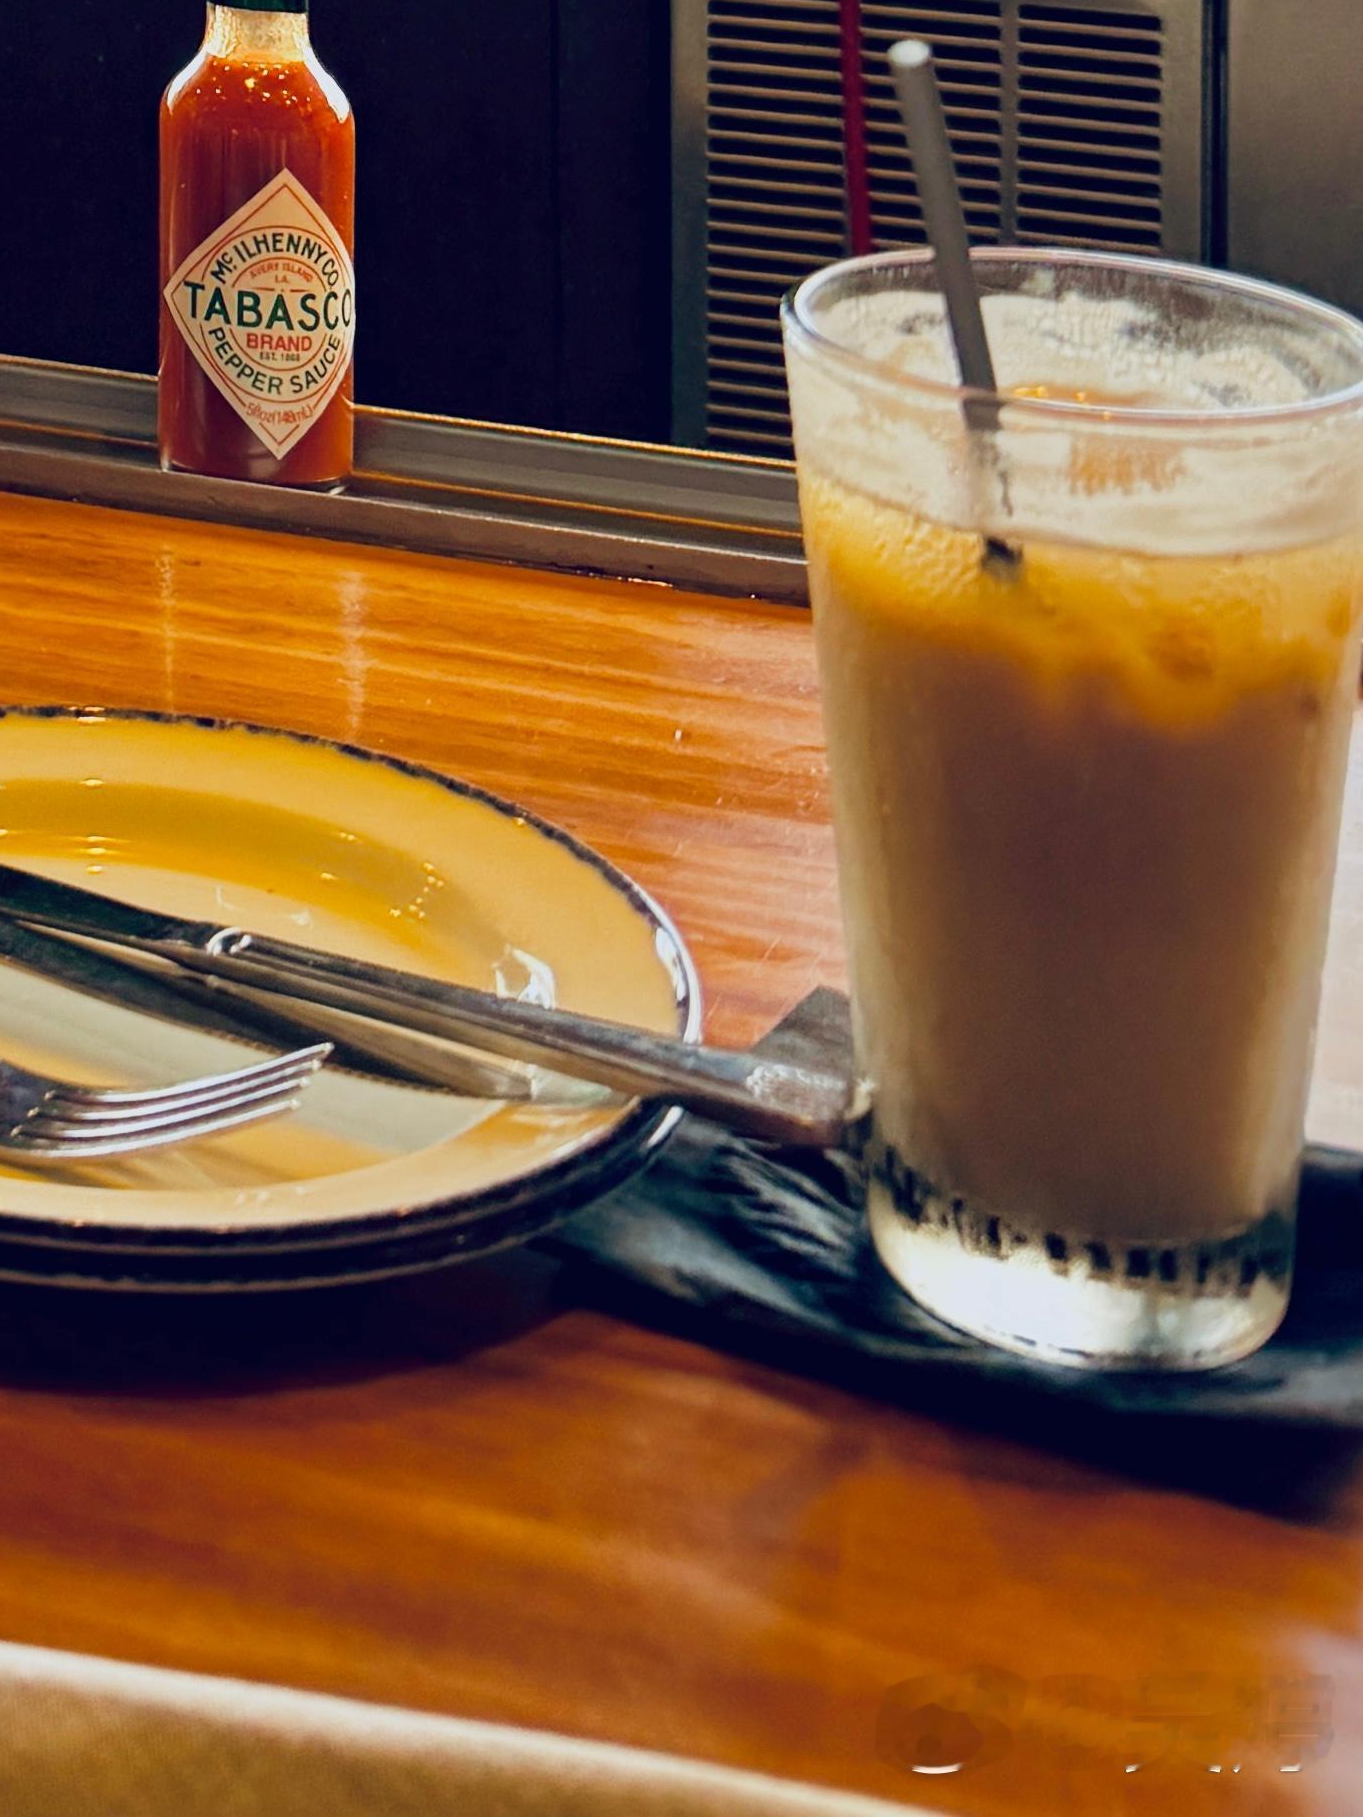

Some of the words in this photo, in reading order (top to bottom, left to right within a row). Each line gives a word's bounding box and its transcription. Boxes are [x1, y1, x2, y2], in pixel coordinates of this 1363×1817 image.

[184, 280, 352, 332] TABASCO
[208, 327, 283, 395] PEPPER
[290, 334, 341, 394] SAUCE
[246, 333, 312, 352] BRAND
